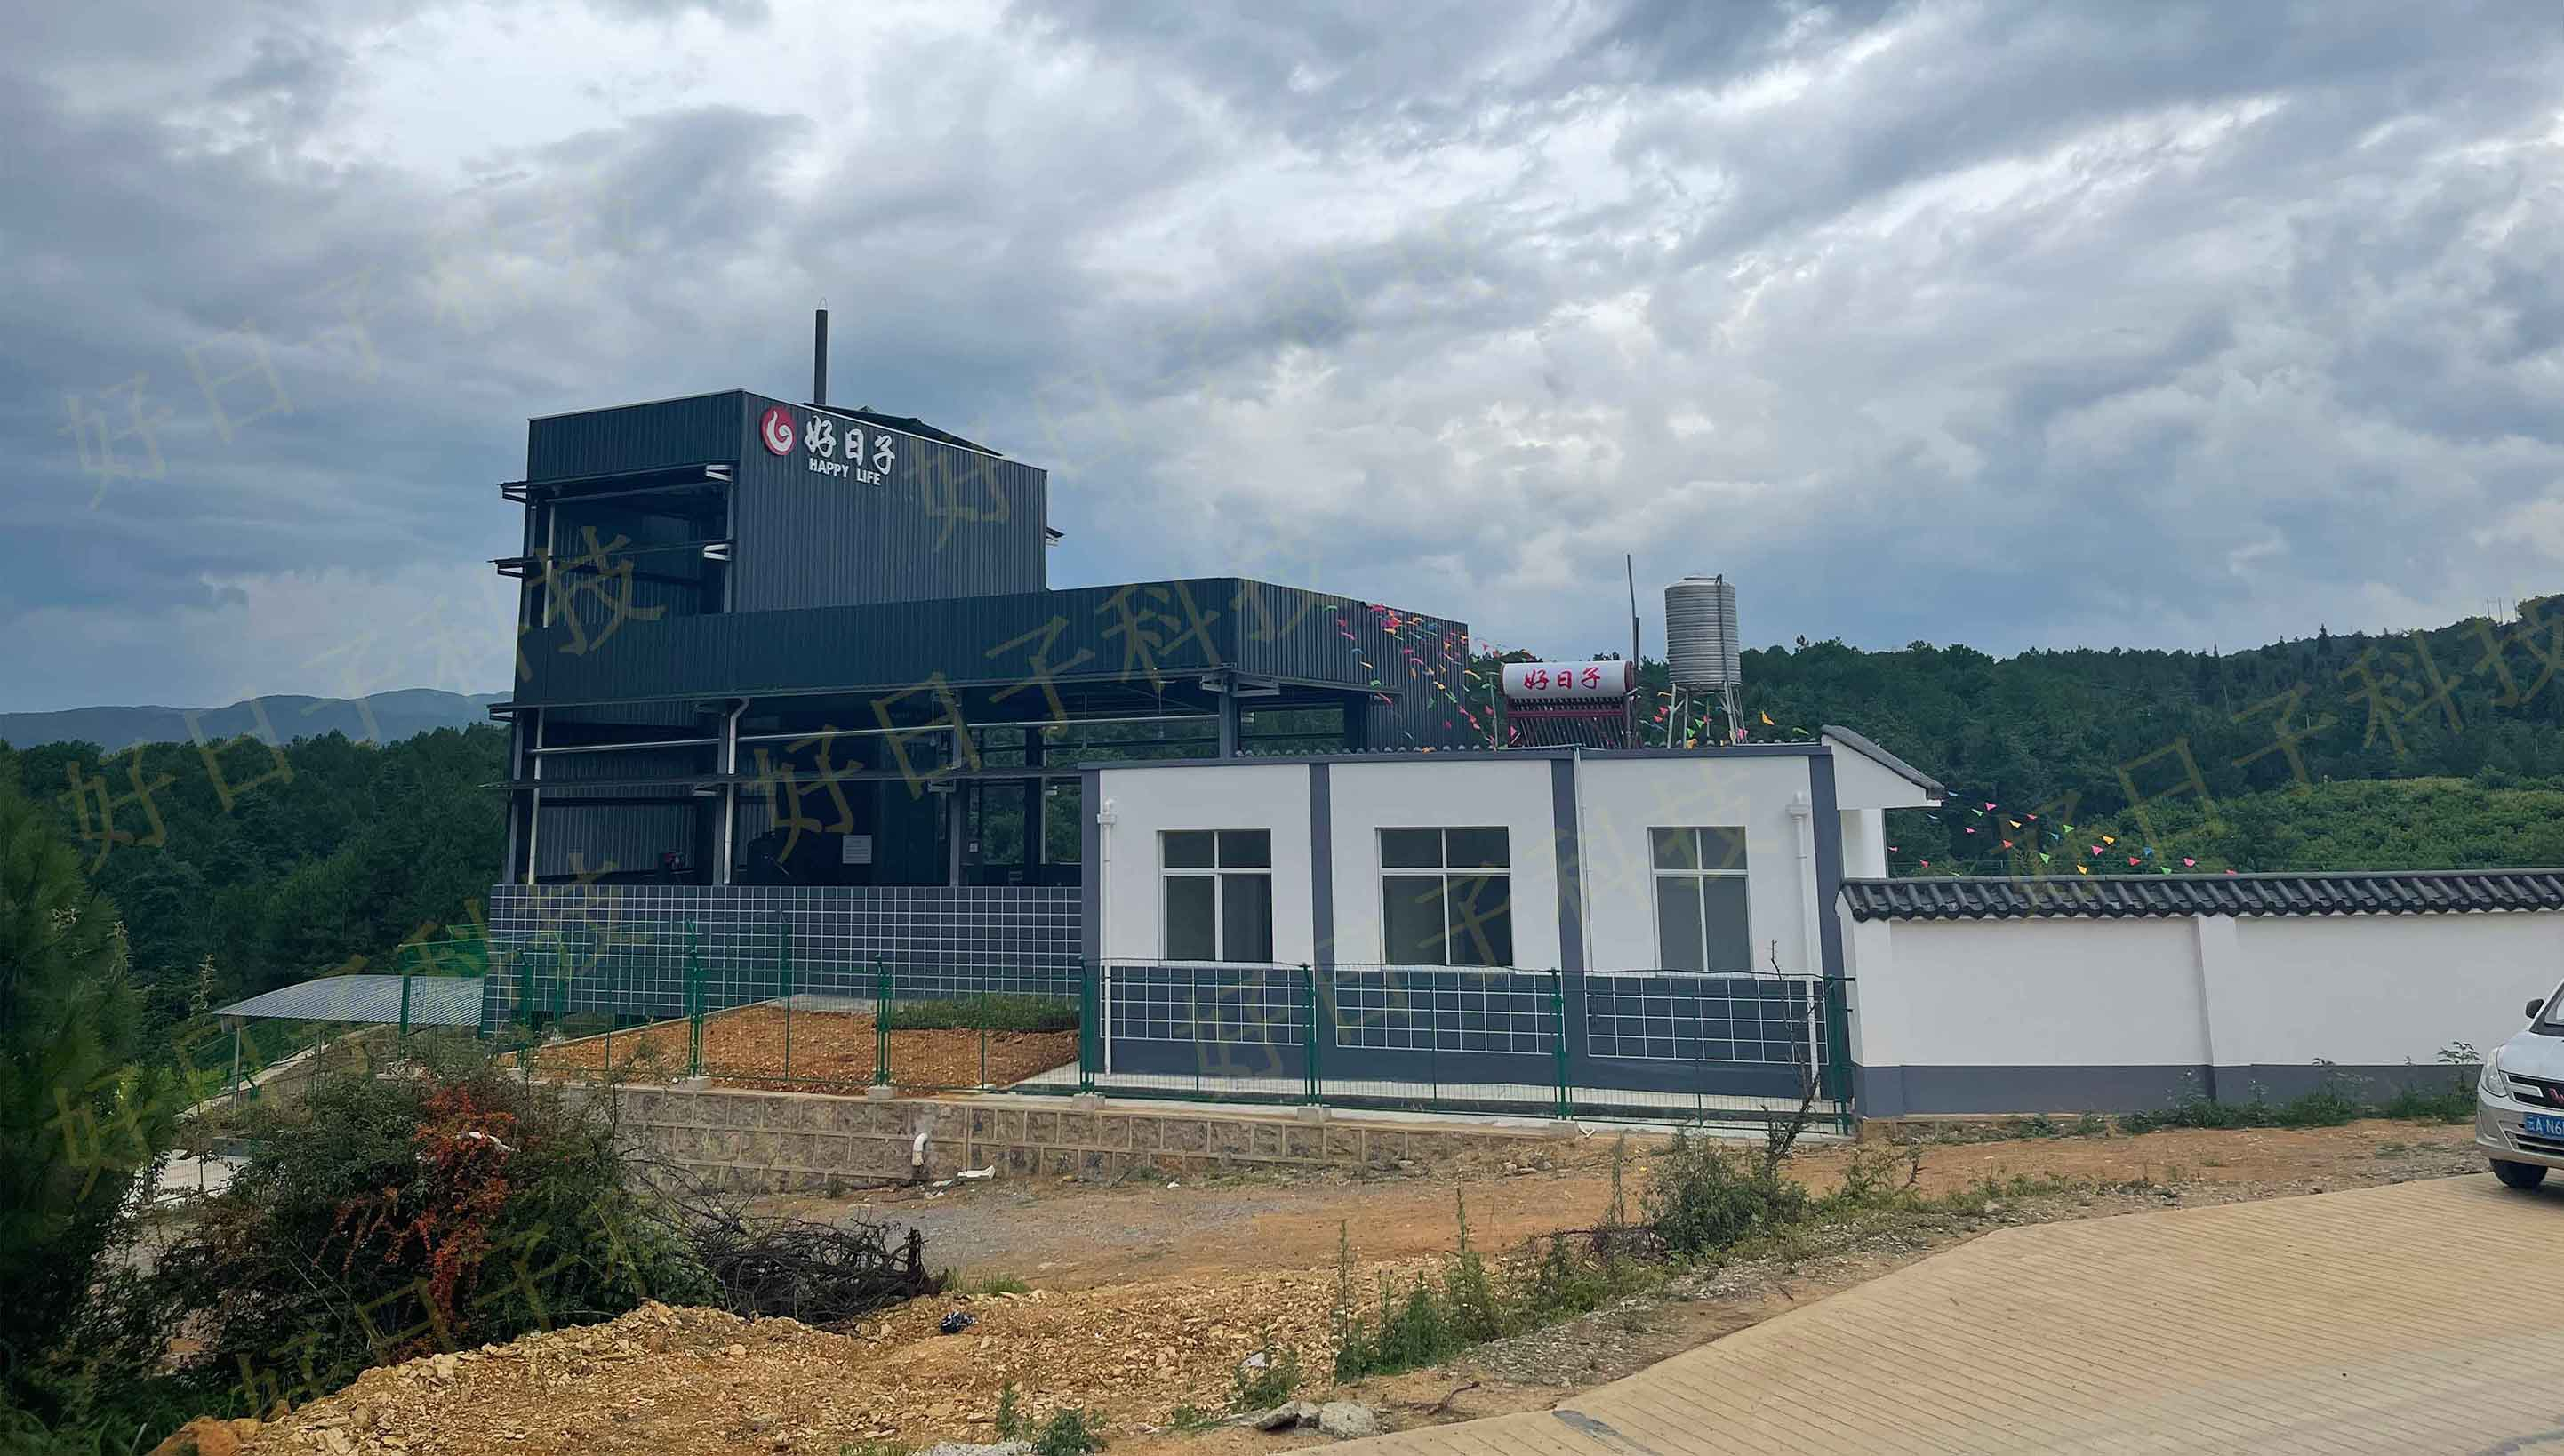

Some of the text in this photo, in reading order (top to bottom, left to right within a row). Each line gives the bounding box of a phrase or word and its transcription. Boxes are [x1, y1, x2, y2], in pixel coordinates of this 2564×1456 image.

[805, 415, 895, 475] 好日子
[809, 458, 881, 486] HAPPY LIFE
[1523, 667, 1601, 691] 好日子
